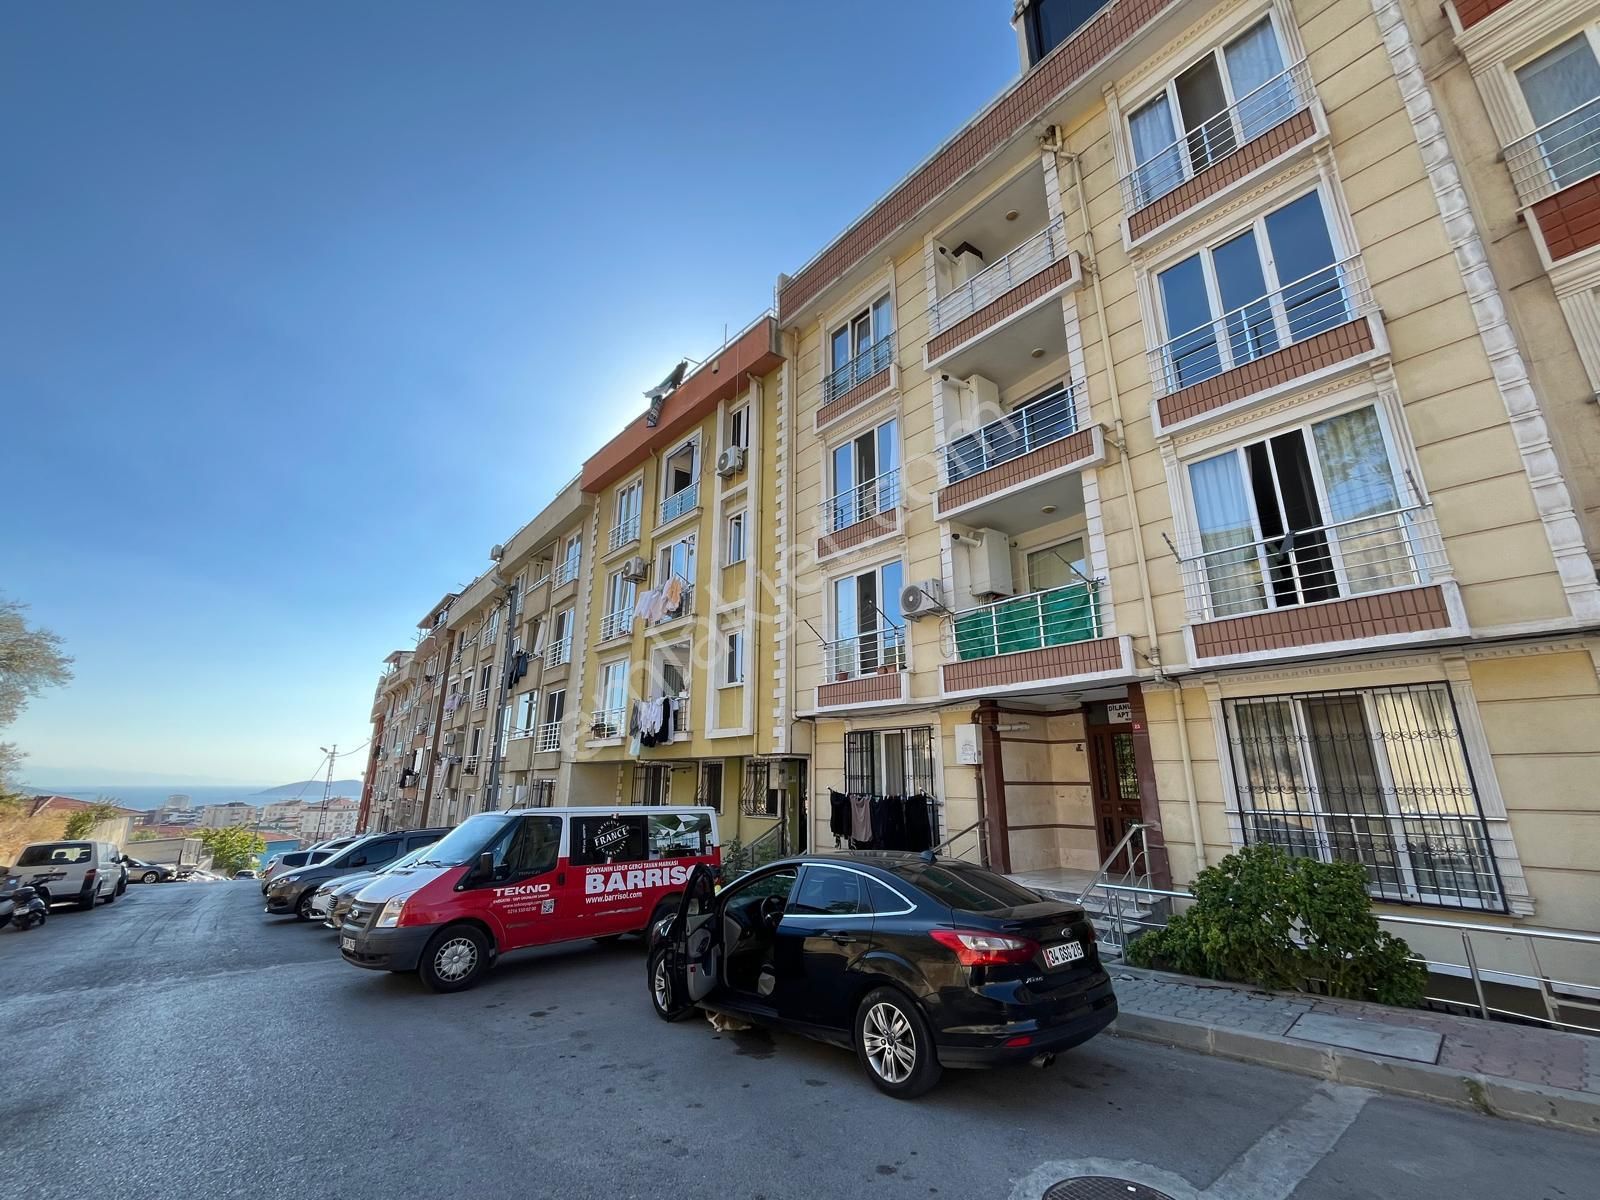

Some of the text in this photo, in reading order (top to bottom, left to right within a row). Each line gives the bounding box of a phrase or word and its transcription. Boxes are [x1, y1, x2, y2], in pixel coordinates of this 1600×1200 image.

[1117, 711, 1129, 719] APT
[594, 827, 628, 847] FRANCE
[586, 866, 613, 874] DÜNYANIN
[493, 884, 551, 897] TEKNO
[585, 891, 642, 904] www.barrisol.com
[1049, 949, 1059, 964] 34
